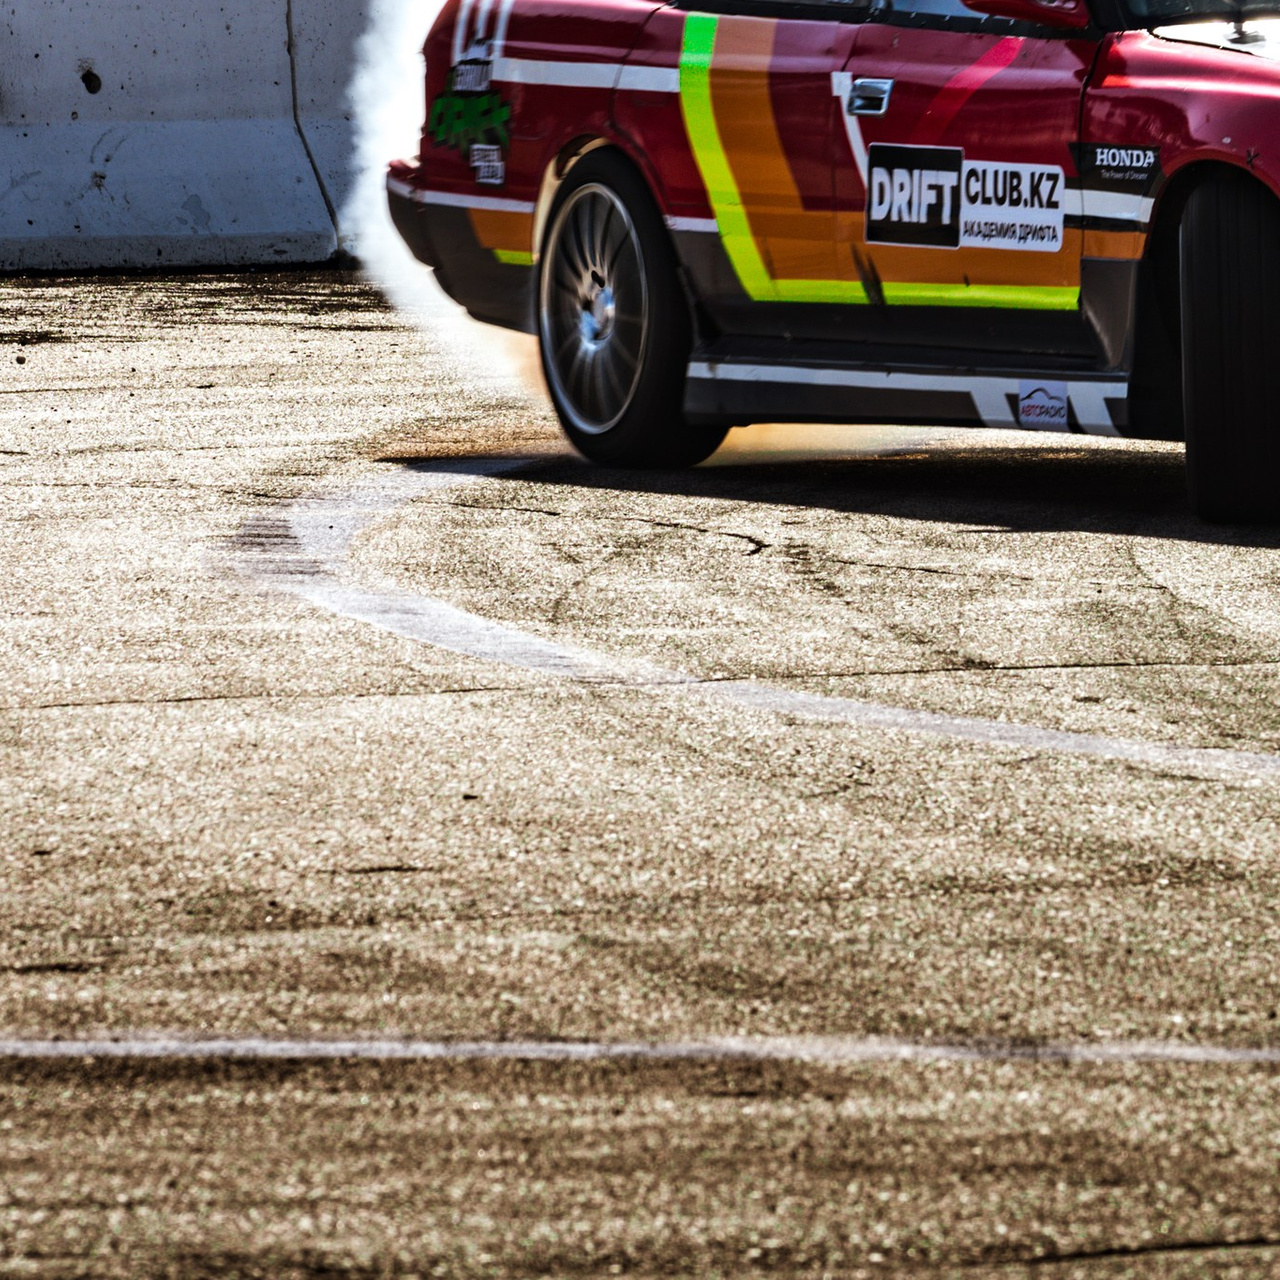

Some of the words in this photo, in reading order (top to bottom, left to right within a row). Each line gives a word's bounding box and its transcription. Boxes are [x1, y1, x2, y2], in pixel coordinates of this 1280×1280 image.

[1095, 148, 1155, 167] HONDA
[870, 167, 959, 225] DRIFT
[965, 167, 1060, 209] CLUB.KZ
[962, 219, 1018, 241] АКАДЕМИЯ
[1017, 223, 1059, 245] ДРИФТА
